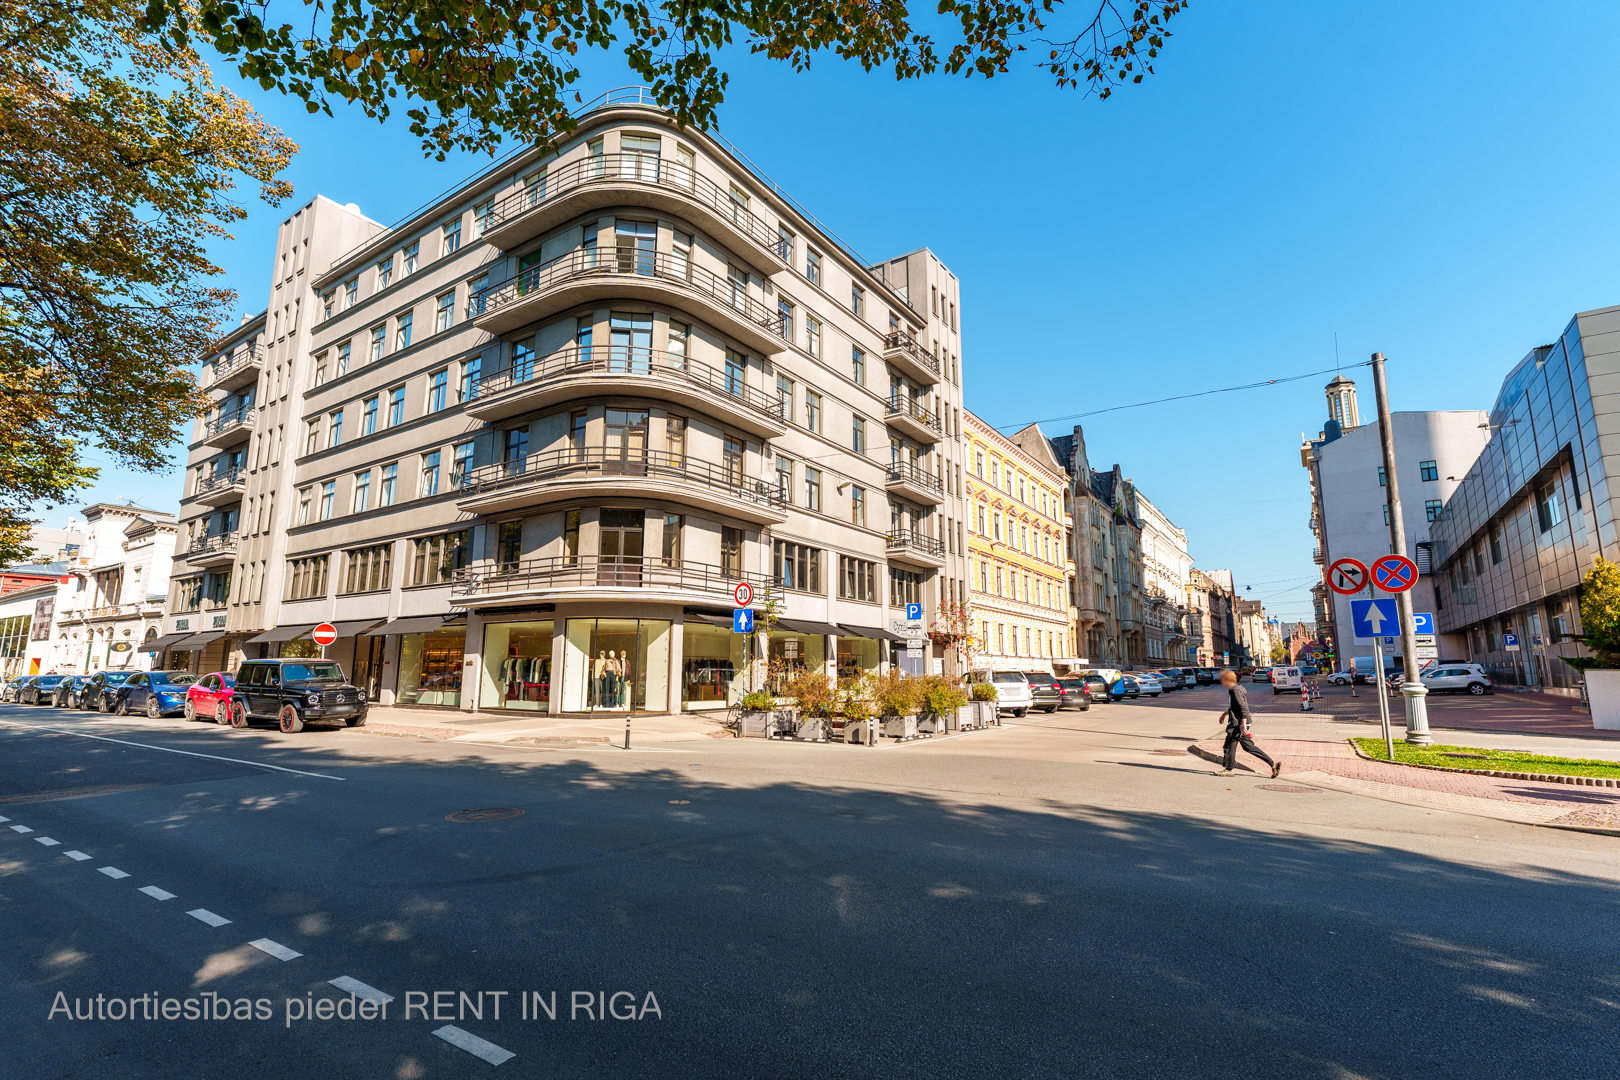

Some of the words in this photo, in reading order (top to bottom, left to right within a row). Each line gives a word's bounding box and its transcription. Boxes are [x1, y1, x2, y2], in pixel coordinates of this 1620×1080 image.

[739, 588, 748, 599] 30
[910, 606, 918, 618] P
[1413, 615, 1427, 632] P
[1506, 635, 1515, 644] P
